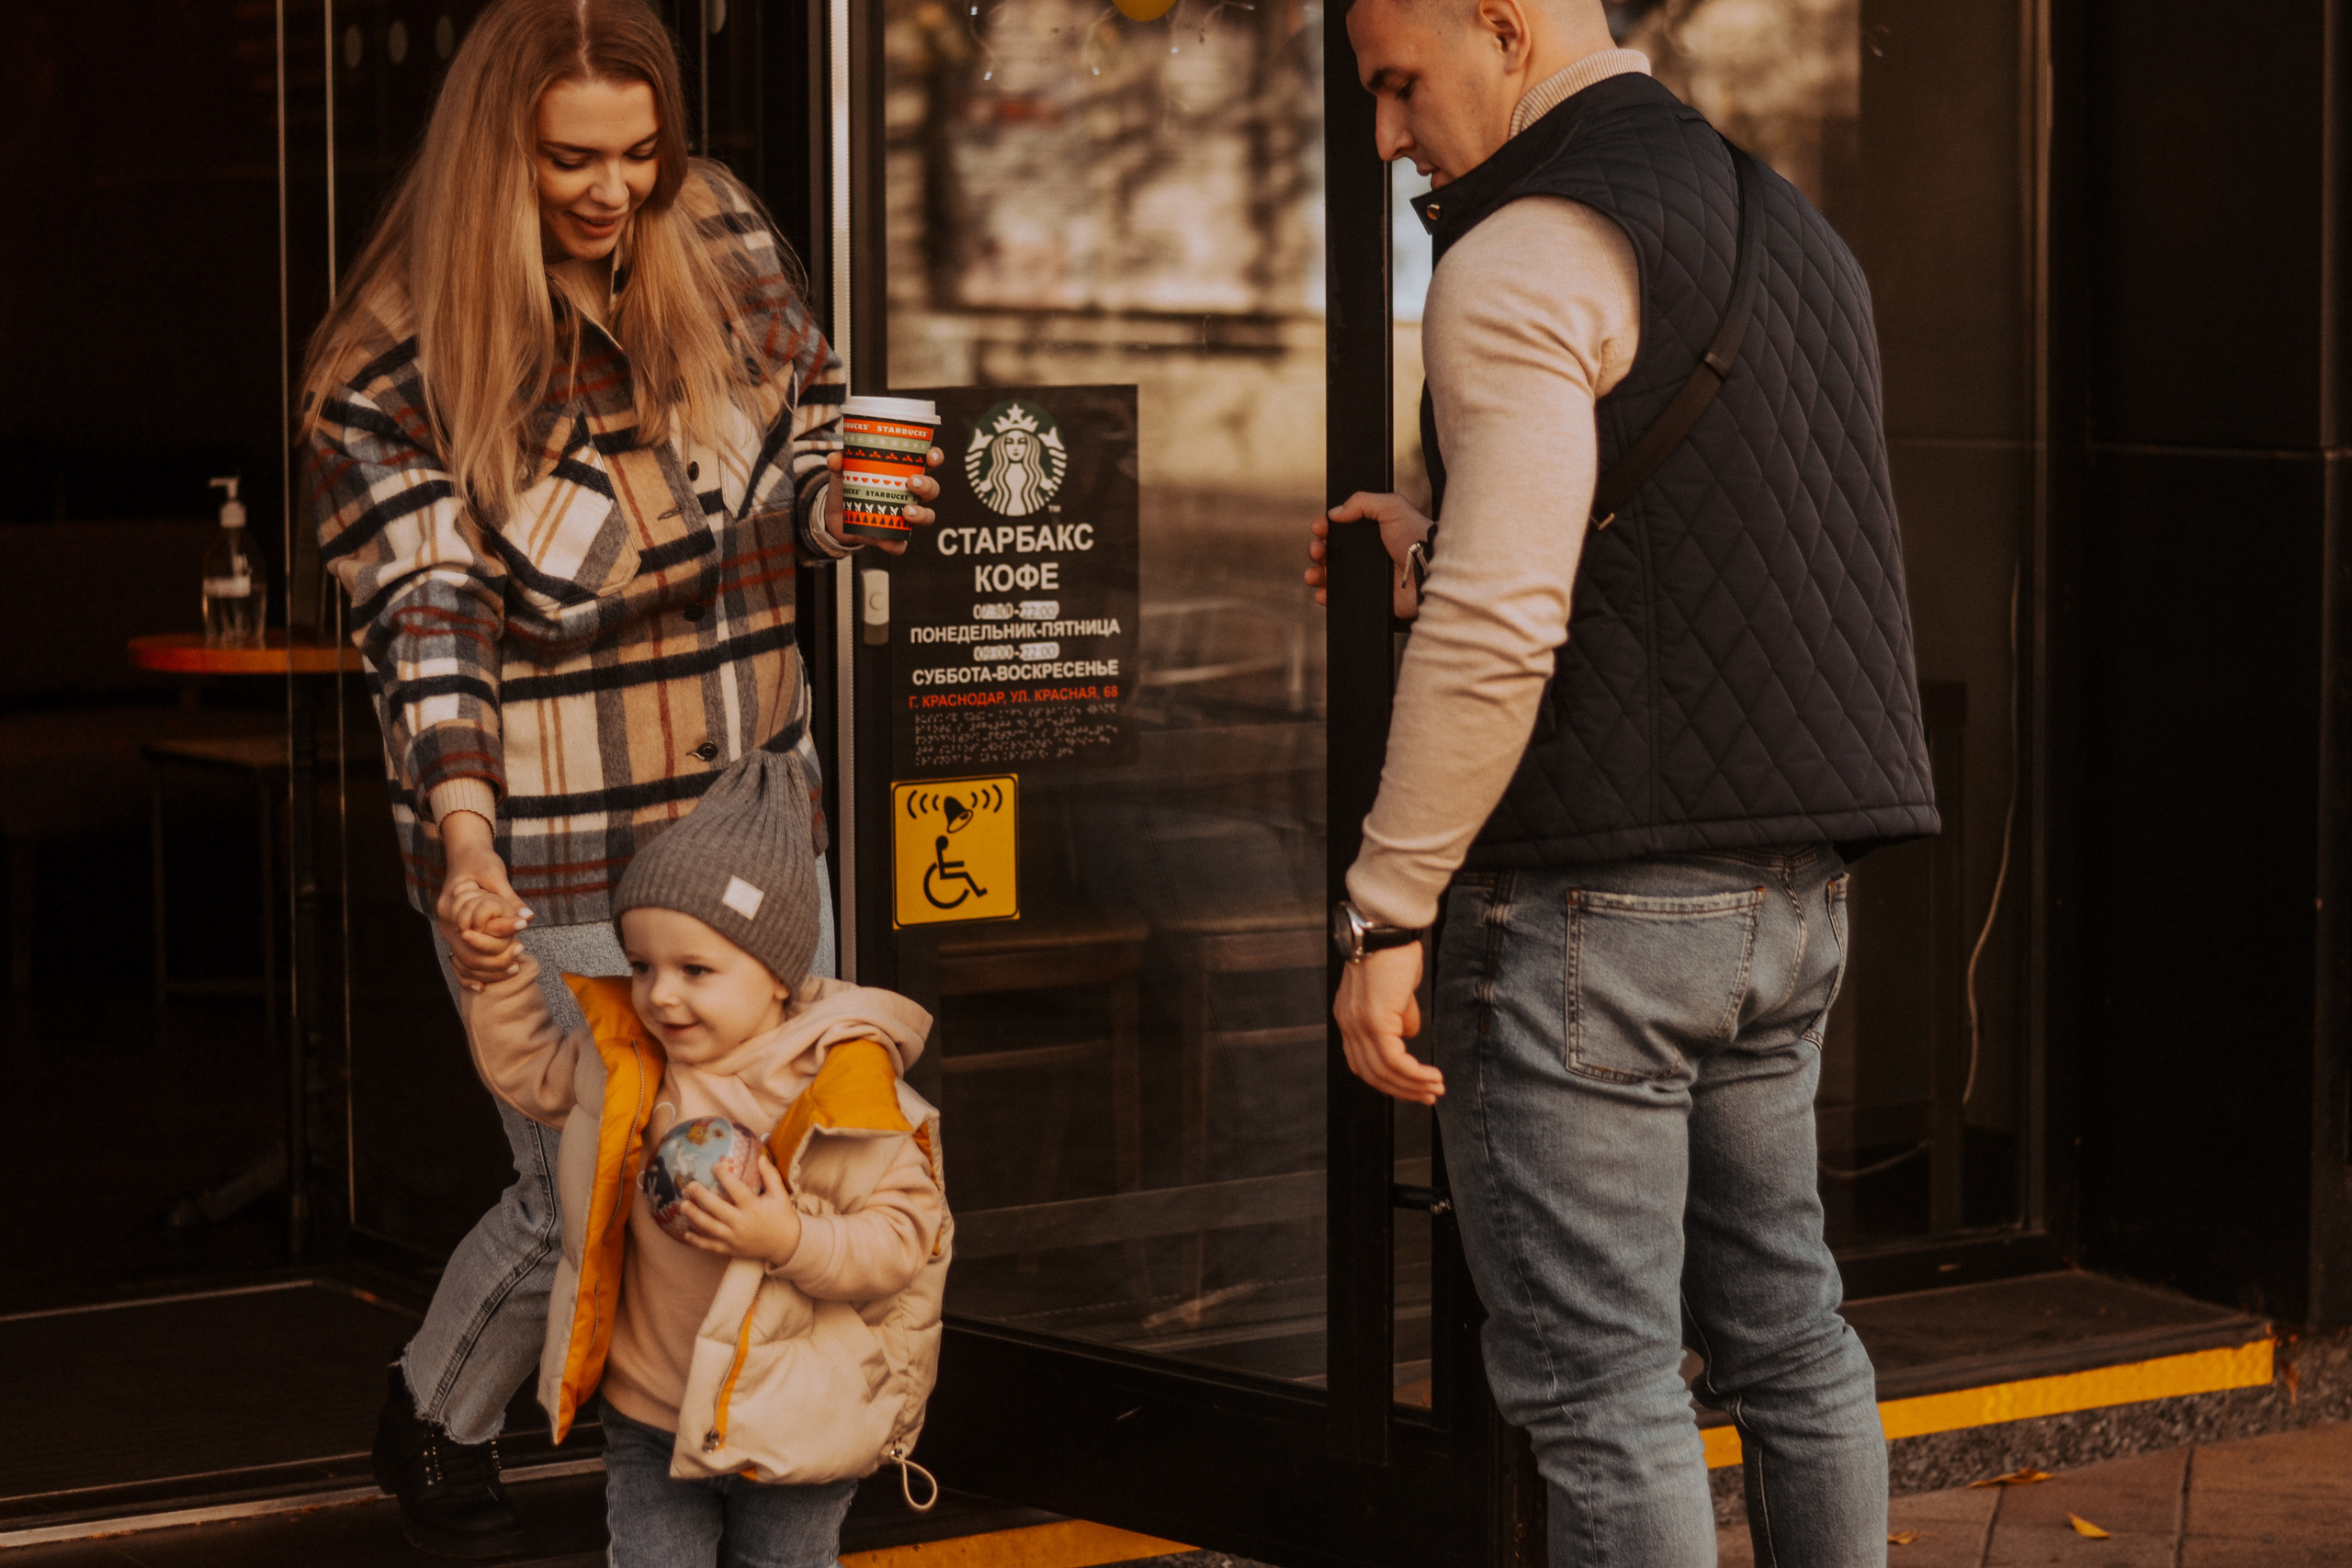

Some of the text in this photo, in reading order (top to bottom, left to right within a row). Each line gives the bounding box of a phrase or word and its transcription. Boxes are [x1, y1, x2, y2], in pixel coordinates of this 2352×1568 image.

[876, 425, 927, 437] STARBUCKS
[865, 491, 909, 501] STARBUCKS
[937, 523, 1094, 556] СТАРБАКС
[975, 562, 1059, 592] КОФЕ
[910, 617, 1121, 644] ПОНЕДЕЛЬНИК-ПЯТНИЦА
[912, 660, 1119, 685] СУББОТА-ВОСКРЕСЕНЬЕ
[909, 685, 1118, 708] Г. КРАСНОДАР, УЛ. КРАСНАЯ, 68
